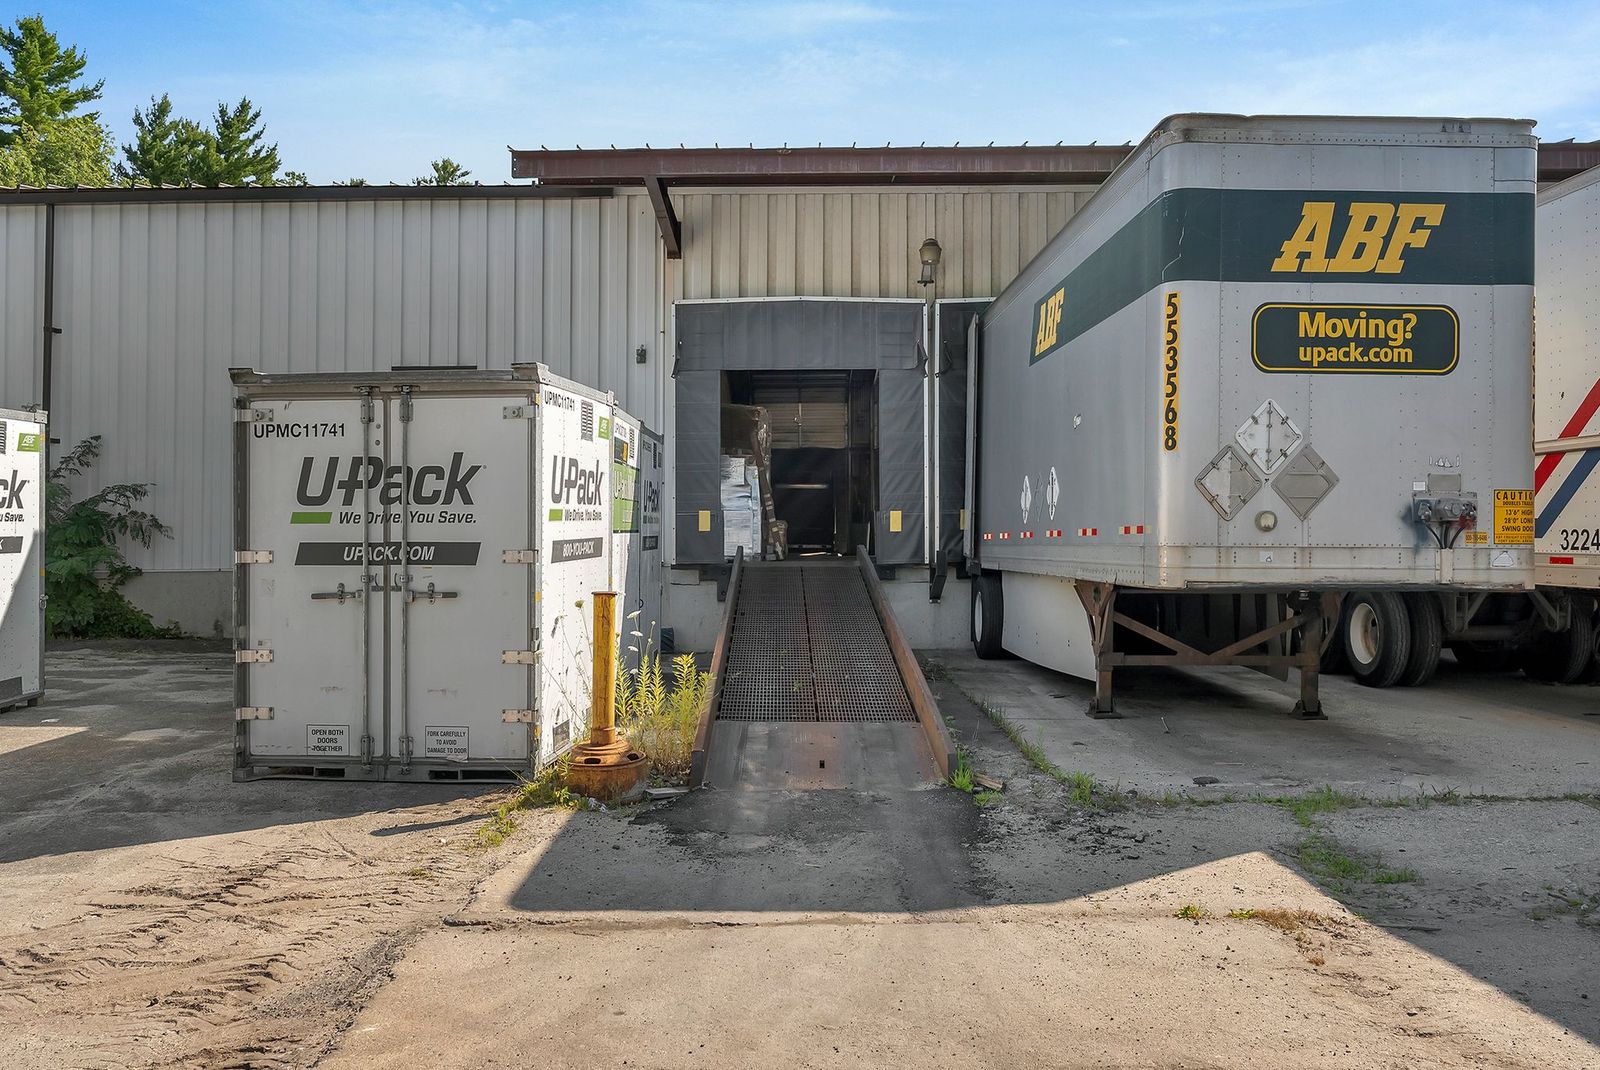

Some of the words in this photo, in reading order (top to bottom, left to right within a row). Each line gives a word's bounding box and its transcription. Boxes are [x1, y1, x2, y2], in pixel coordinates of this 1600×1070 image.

[1271, 202, 1446, 273] ABF
[1035, 287, 1065, 356] ABF
[1298, 311, 1418, 346] Moving?
[1299, 342, 1413, 367] upack.com
[1165, 293, 1178, 451] 553568
[253, 423, 345, 438] UPMC11741
[4, 512, 24, 522] Save.
[339, 512, 361, 524] We
[409, 511, 434, 523] You
[438, 511, 477, 524] Save.
[343, 546, 435, 561] UPACK.COM
